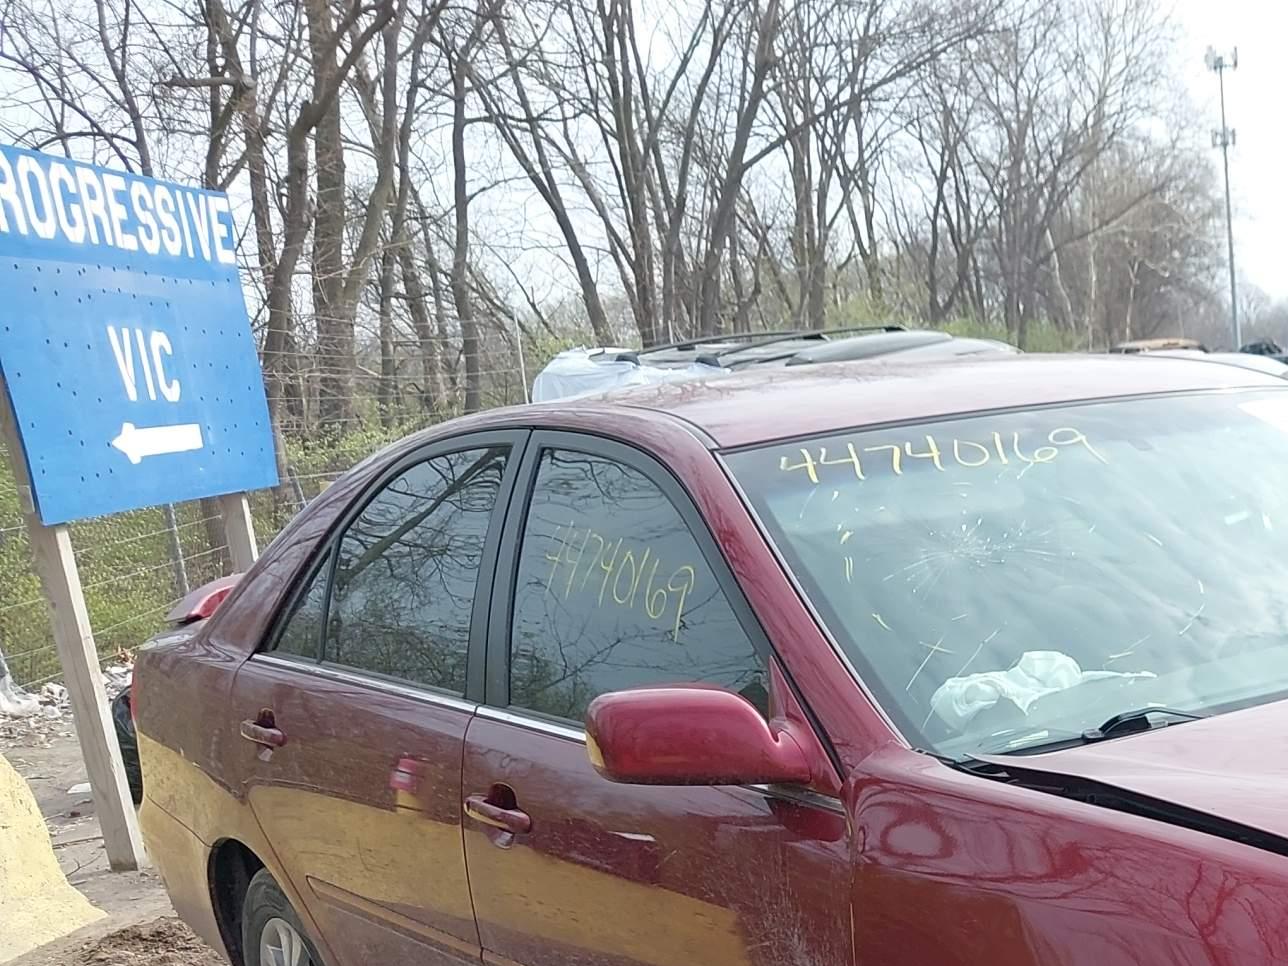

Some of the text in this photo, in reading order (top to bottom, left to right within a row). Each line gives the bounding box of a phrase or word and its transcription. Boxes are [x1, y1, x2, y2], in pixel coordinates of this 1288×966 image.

[107, 324, 182, 403] VIC
[779, 427, 1109, 484] 44740169
[545, 520, 696, 643] 44740169
